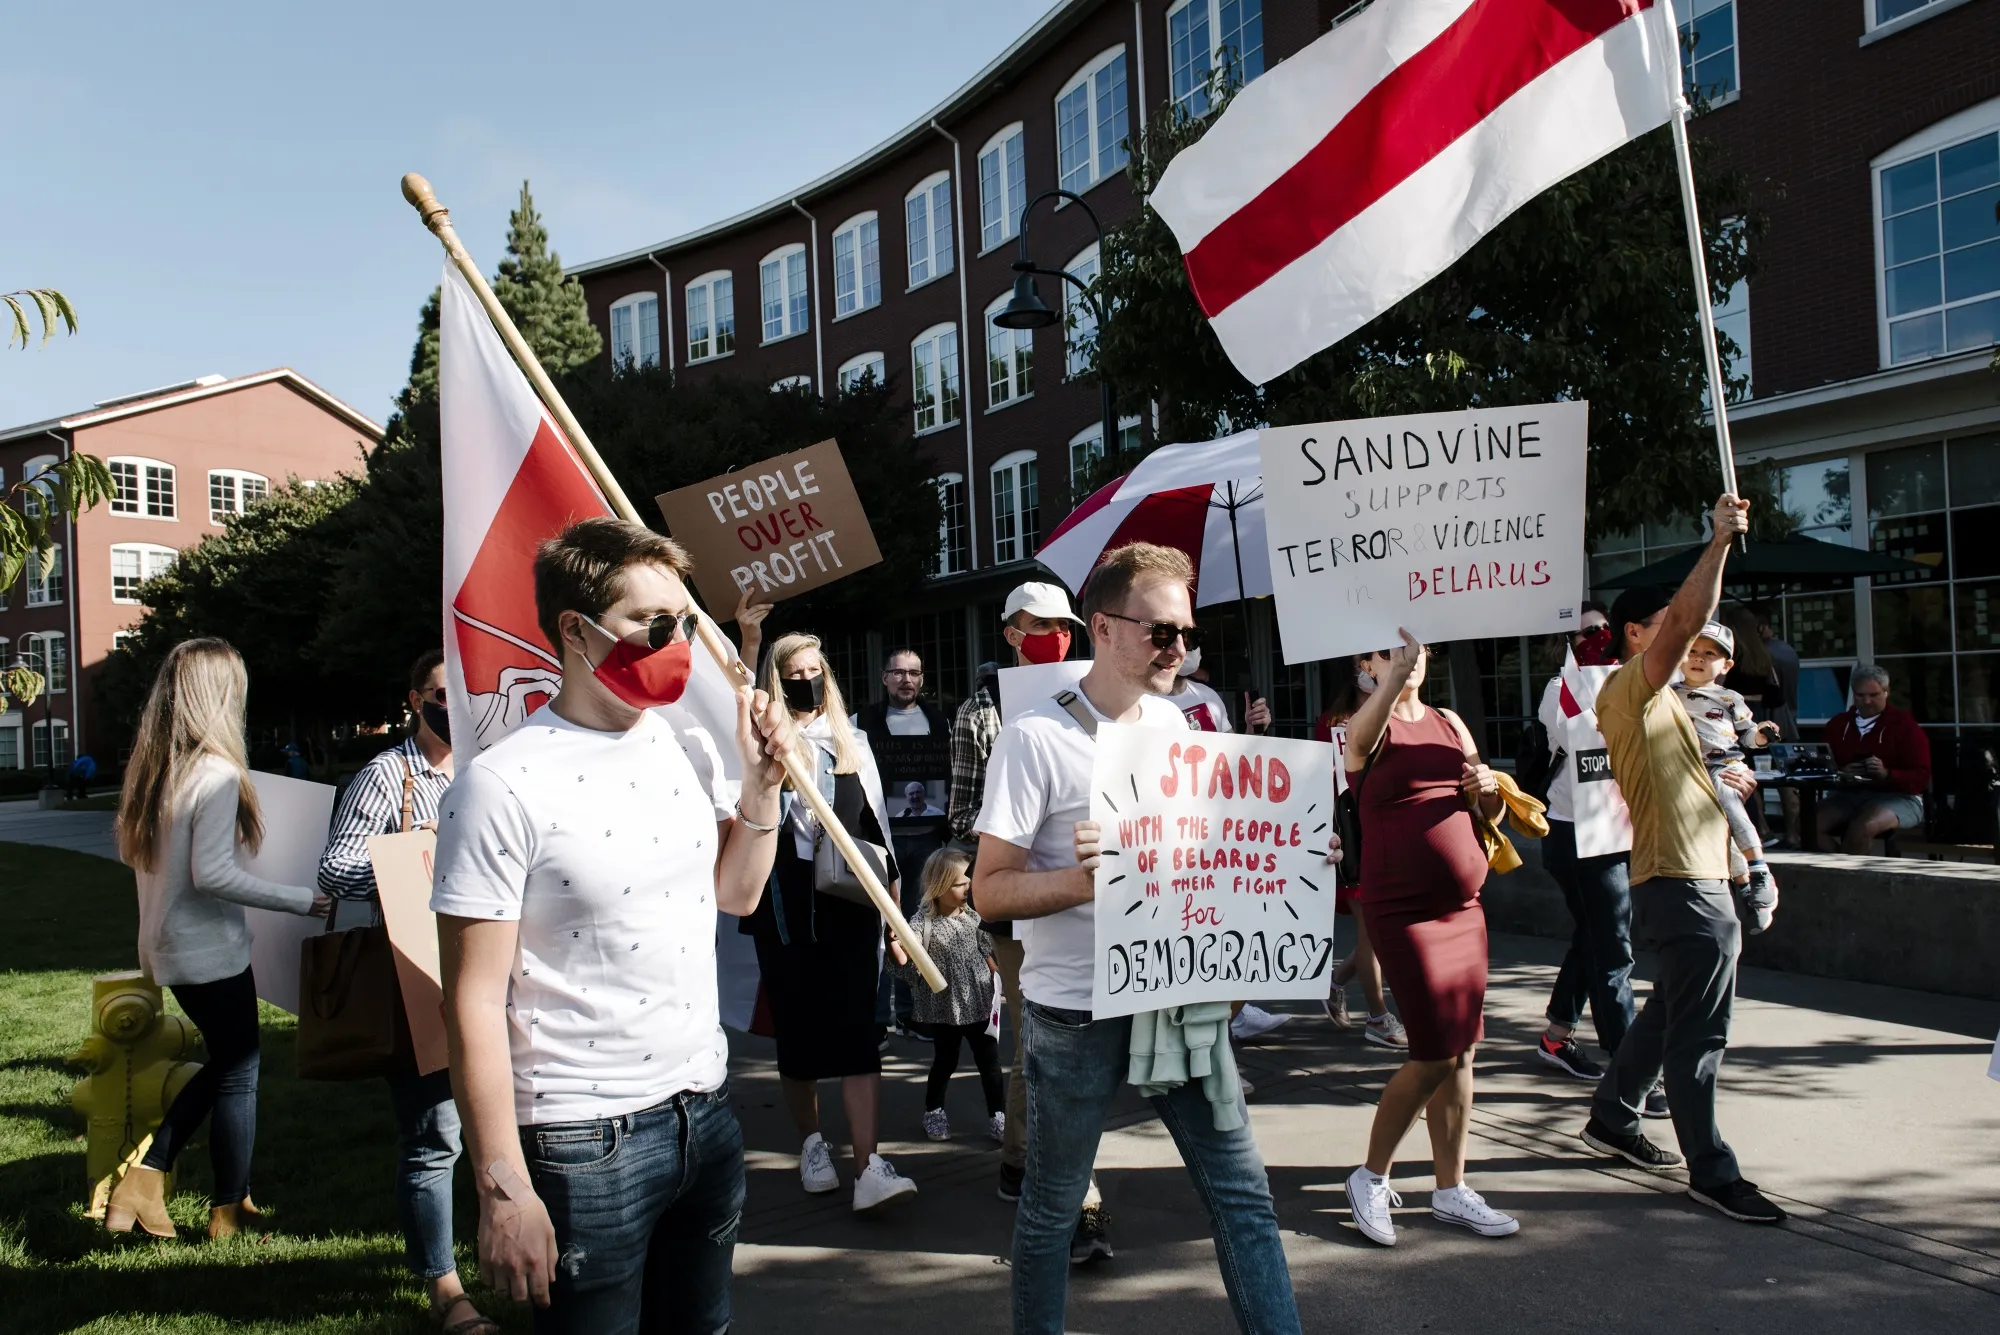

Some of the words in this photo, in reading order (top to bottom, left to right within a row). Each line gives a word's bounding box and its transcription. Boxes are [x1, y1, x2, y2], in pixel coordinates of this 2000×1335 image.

[707, 460, 820, 523] PEOPLE
[1344, 476, 1507, 518] SUPPORTS
[737, 501, 823, 552] OVER
[730, 529, 843, 593] PROFIT
[1277, 528, 1408, 577] TERROR
[1413, 523, 1428, 552] &
[1408, 560, 1551, 601] BELARUS
[1160, 742, 1291, 803] STAND
[1581, 755, 1605, 773] STOP
[1118, 814, 1163, 849] WITH
[1177, 816, 1209, 840] THE
[1222, 817, 1302, 847] PEOPLE
[1137, 848, 1159, 873] OF
[1172, 847, 1277, 873] BELARUS
[1146, 880, 1160, 897] IN
[1171, 874, 1216, 894] THEIR
[1232, 875, 1287, 895] FIGHT
[1181, 893, 1225, 931] for
[1108, 929, 1333, 995] DEMOCRACY
